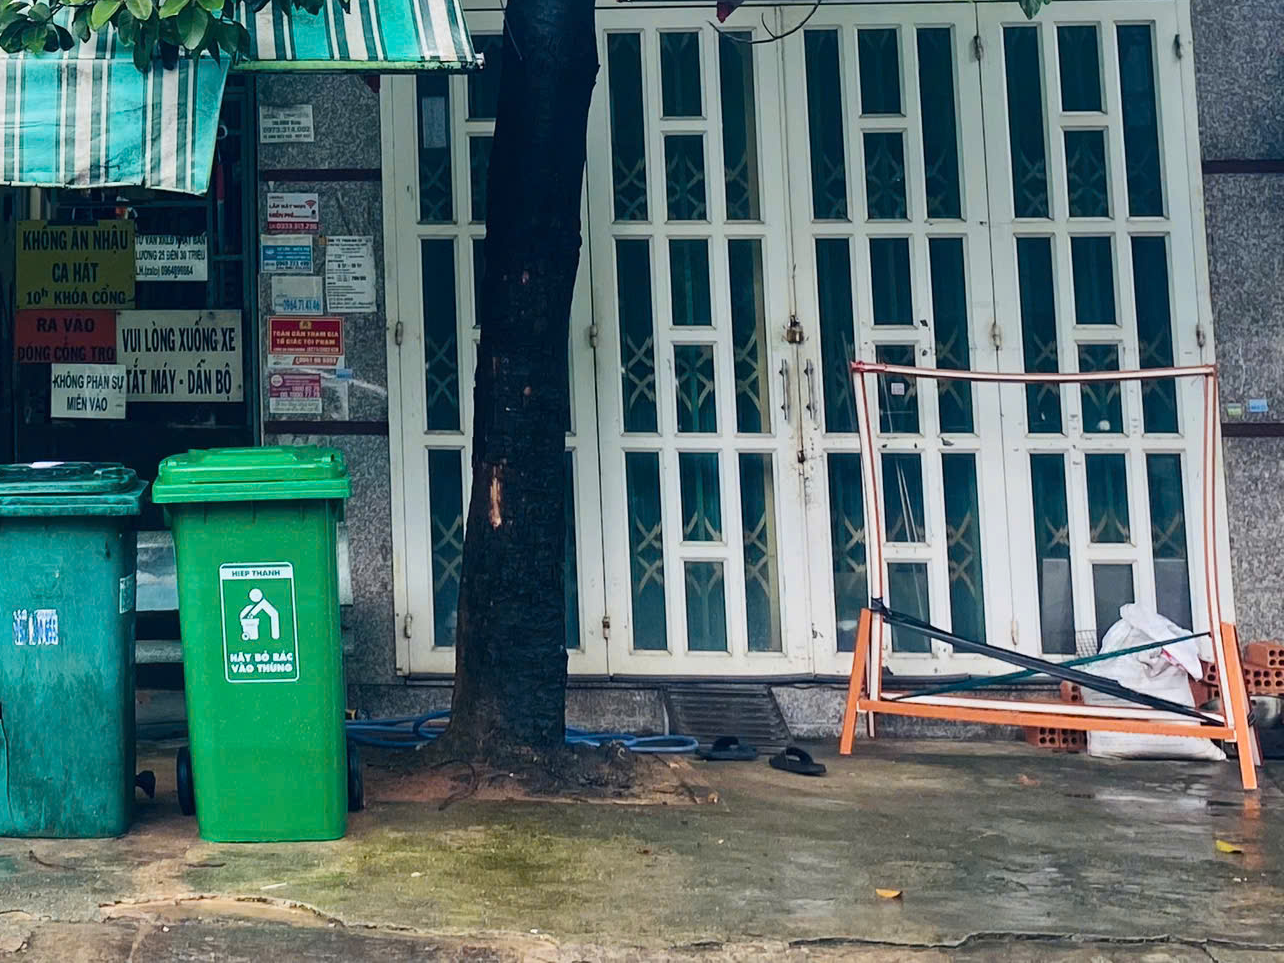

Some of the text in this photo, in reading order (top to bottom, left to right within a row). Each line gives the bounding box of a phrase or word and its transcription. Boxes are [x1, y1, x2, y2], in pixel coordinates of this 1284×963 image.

[23, 225, 67, 251] KHÔNG
[93, 224, 128, 254] NHẬU
[52, 256, 100, 283] CA HÁT
[54, 286, 88, 305] KHÓA
[92, 284, 126, 305] CỔNG
[36, 317, 58, 333] RA
[122, 316, 236, 352] VUI LÒNG XUỐNG XE
[53, 370, 84, 389] KHÔNG
[112, 375, 124, 394] SỰ
[126, 358, 146, 394] TẮT
[151, 362, 176, 394] MÁY
[188, 359, 212, 394] DẪN
[216, 362, 232, 401] BỘ
[230, 661, 255, 674] VÀO
[254, 649, 270, 662] BỎ
[272, 649, 293, 662] RÁC
